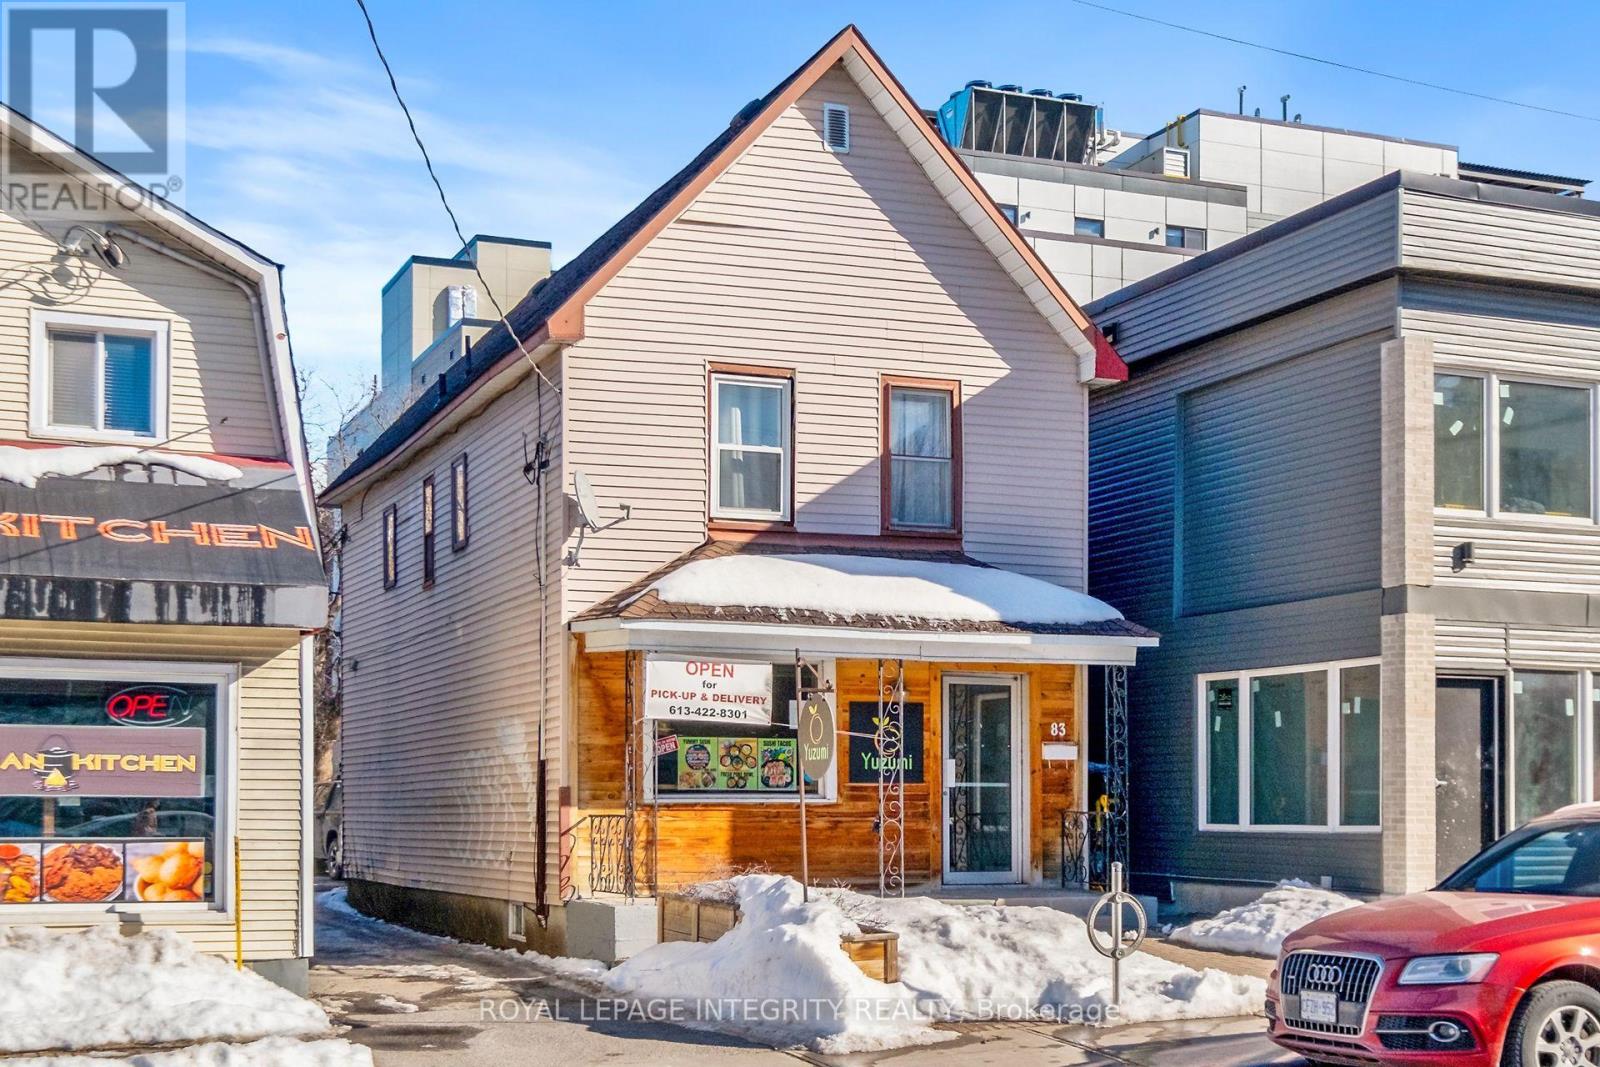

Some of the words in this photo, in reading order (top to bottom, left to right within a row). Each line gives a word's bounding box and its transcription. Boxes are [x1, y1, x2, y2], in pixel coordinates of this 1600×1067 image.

[686, 661, 735, 678] OPEN
[702, 680, 718, 689] for
[651, 689, 697, 701] PICK-UP
[701, 692, 708, 701] &
[712, 693, 768, 705] DELIVERY
[107, 694, 193, 718] OPEN
[669, 705, 748, 719] 613-422-8301
[1050, 722, 1066, 737] 83
[803, 743, 830, 761] Yuzumi
[71, 753, 197, 773] KITCHEN
